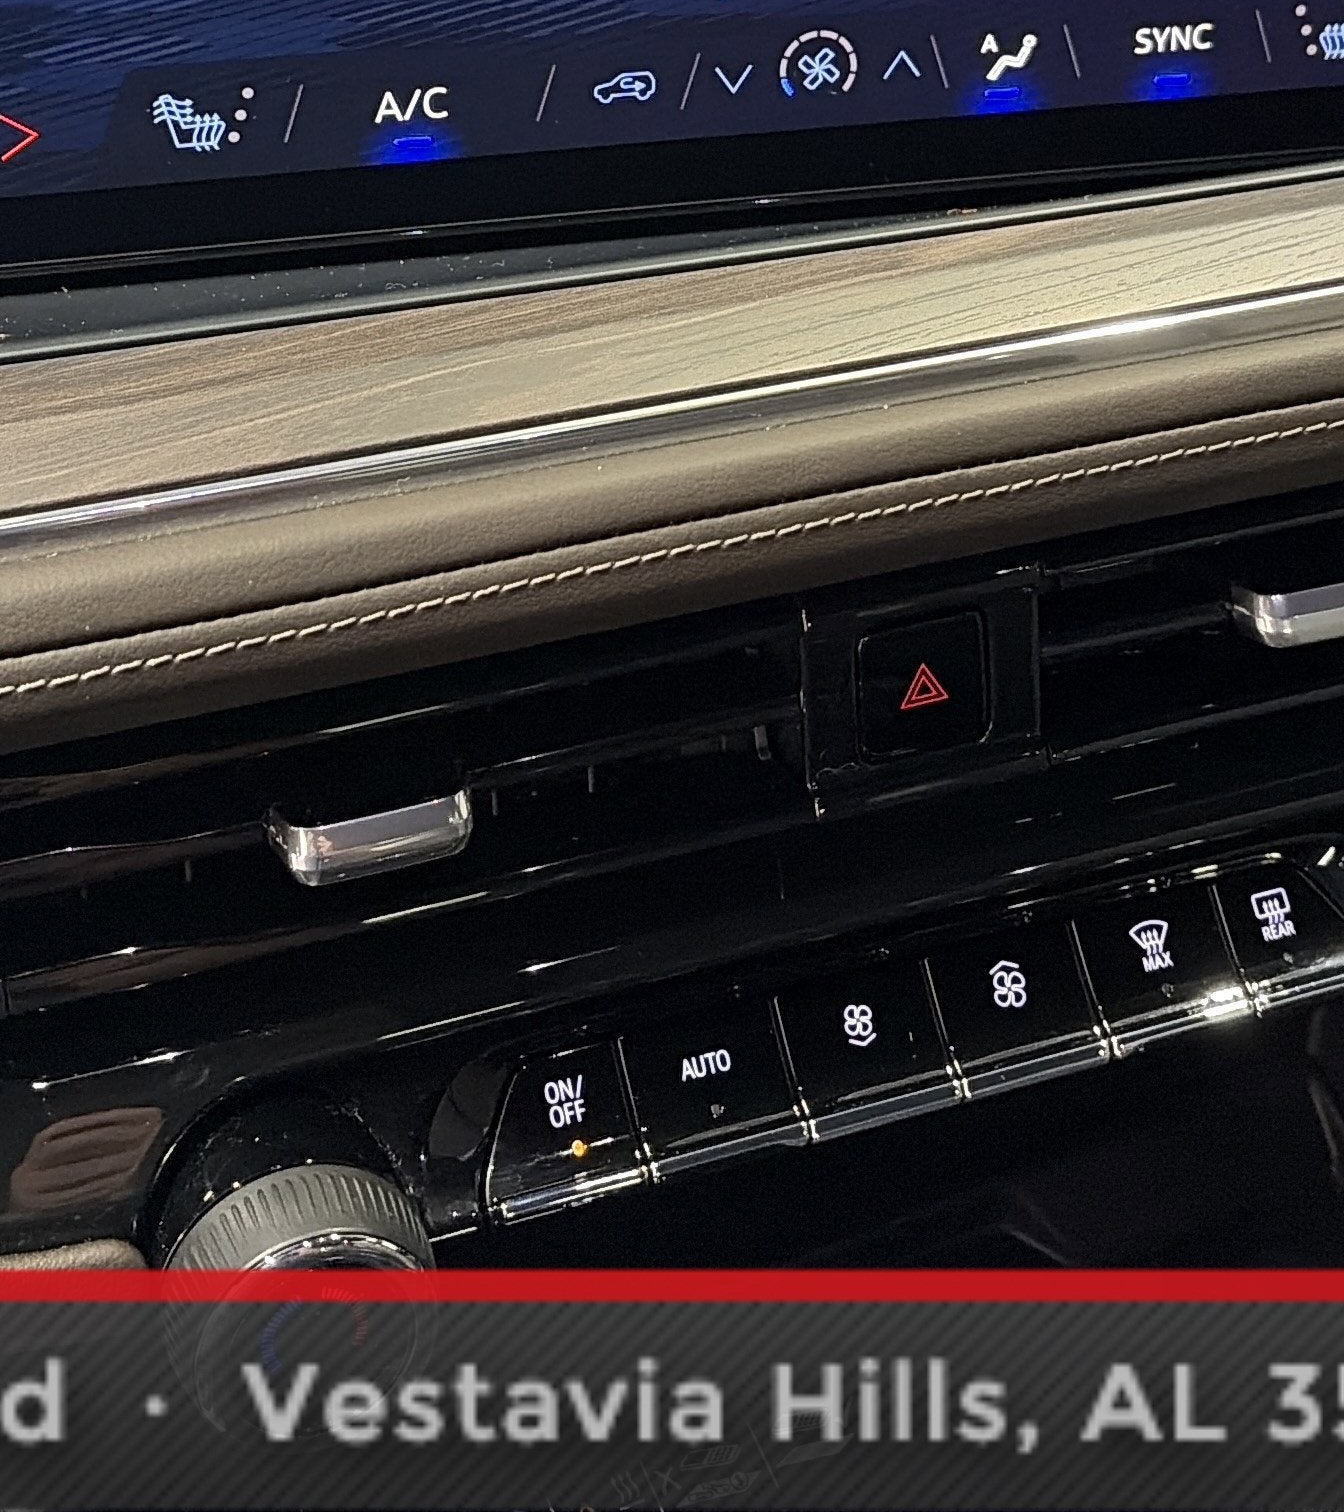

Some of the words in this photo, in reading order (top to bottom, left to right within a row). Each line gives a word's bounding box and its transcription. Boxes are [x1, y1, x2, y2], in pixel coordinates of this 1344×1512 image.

[981, 34, 998, 53] A
[1134, 23, 1212, 54] SYNC
[375, 87, 448, 123] A/C
[1262, 921, 1296, 941] REAR
[1142, 950, 1174, 972] MAX
[682, 1049, 731, 1081] AUTO
[544, 1075, 584, 1105] ON/
[549, 1099, 586, 1128] OFF
